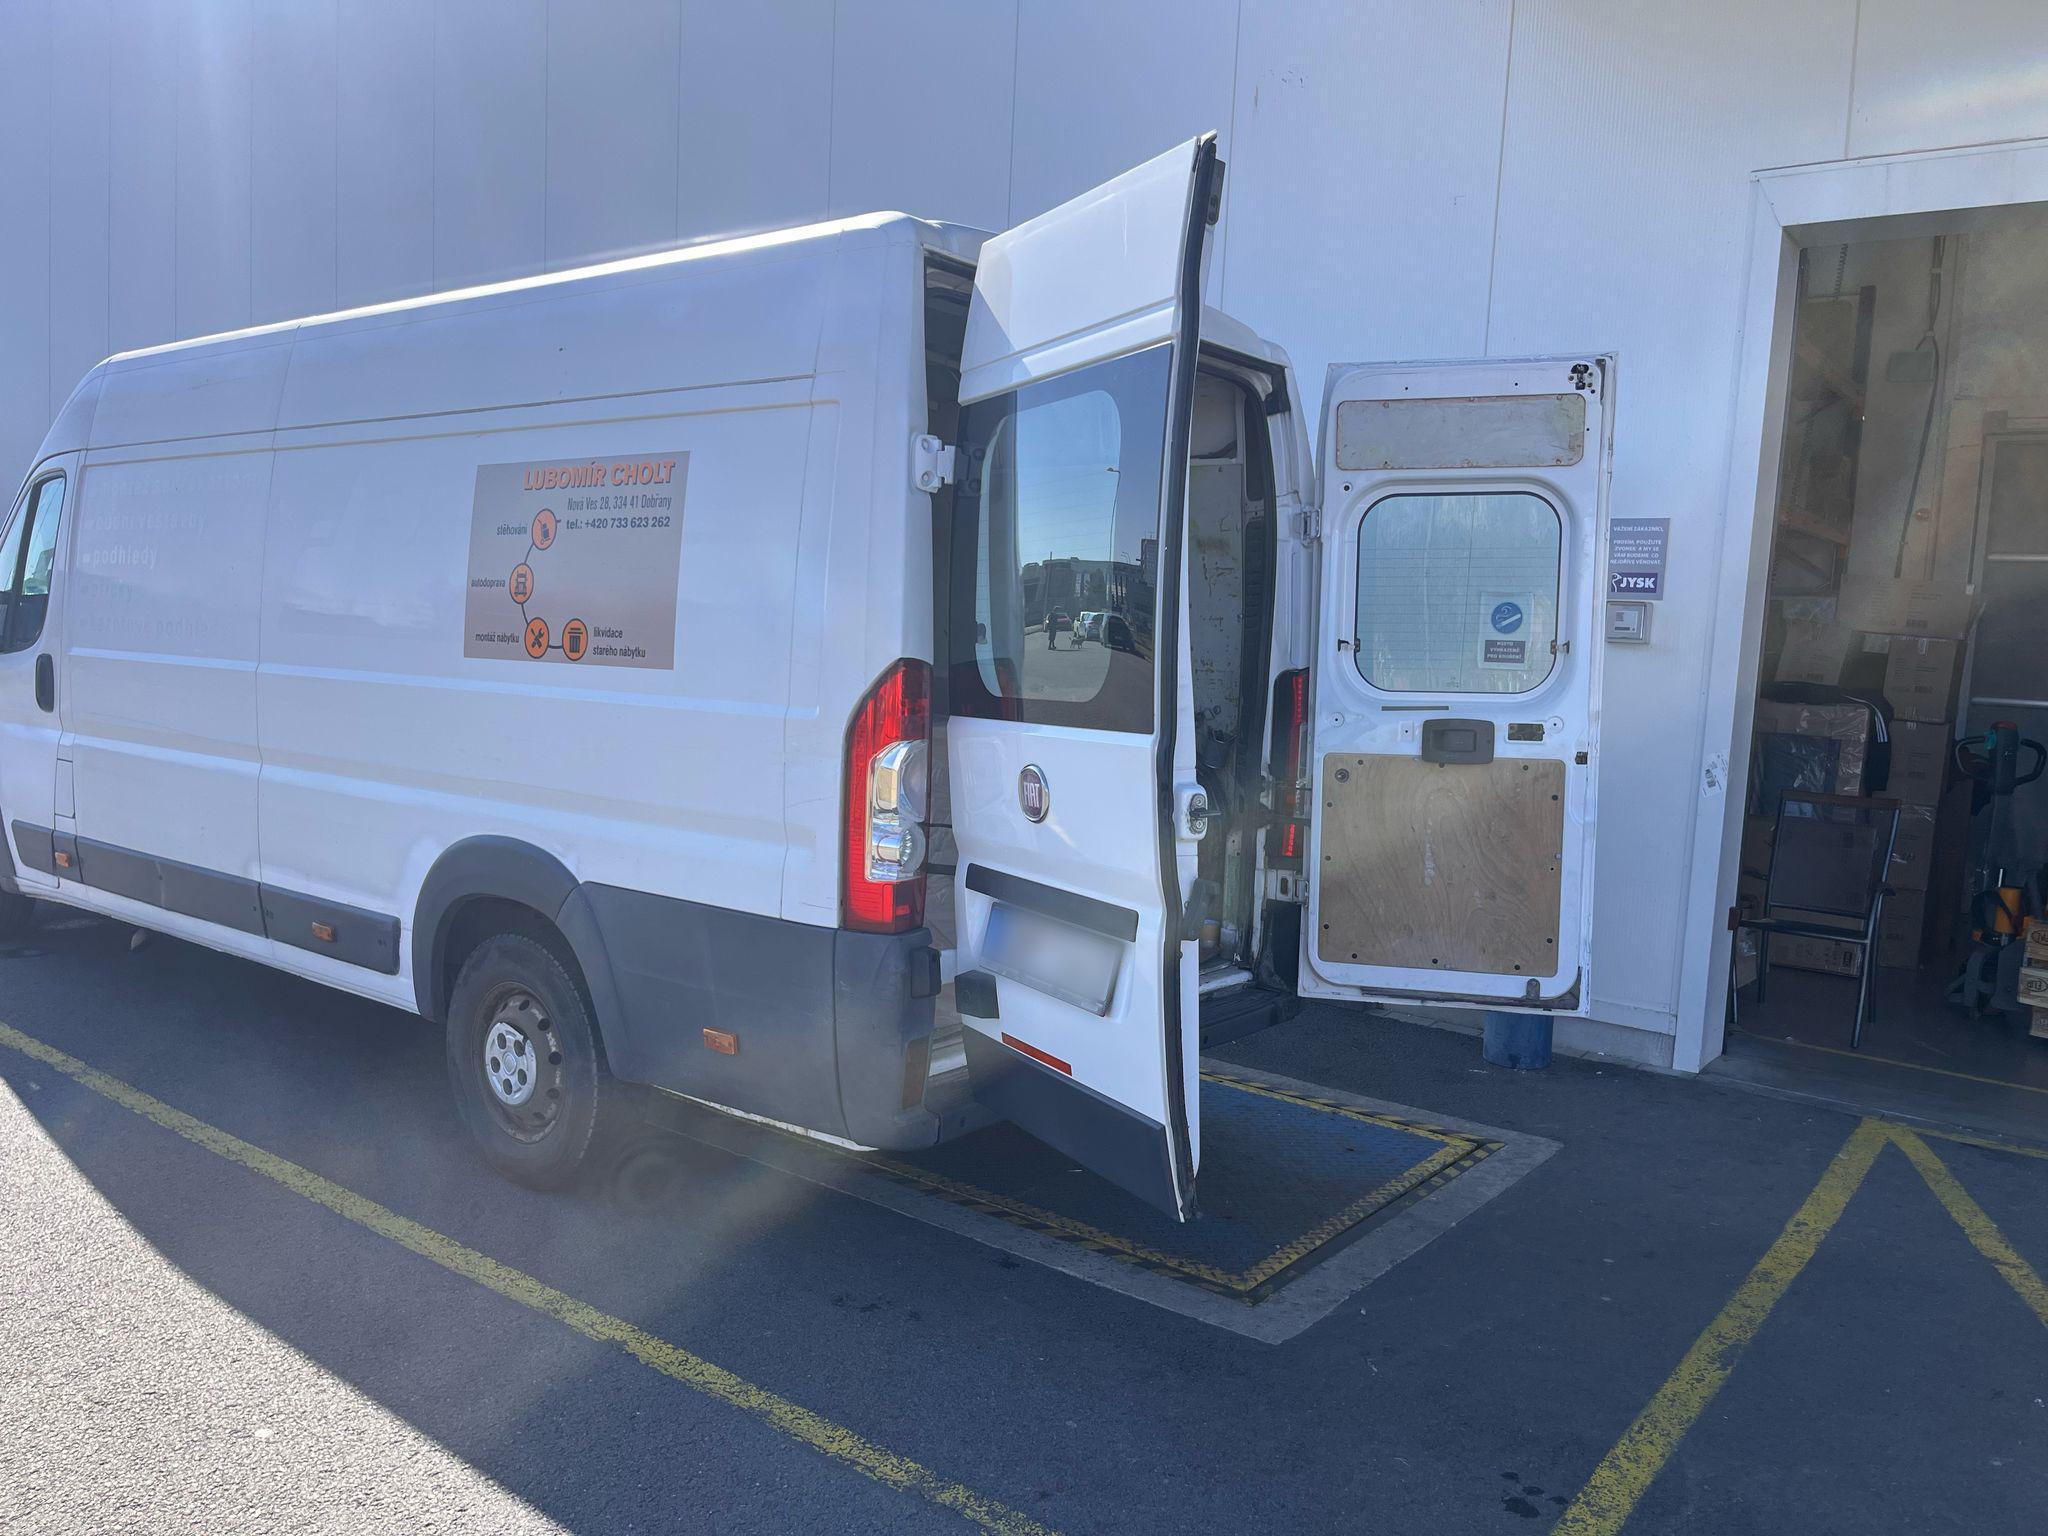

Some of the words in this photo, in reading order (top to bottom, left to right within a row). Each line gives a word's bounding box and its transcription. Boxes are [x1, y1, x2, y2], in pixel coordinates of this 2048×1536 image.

[523, 461, 607, 490] LUBOMÍR
[611, 460, 676, 486] CHOLT
[567, 496, 585, 511] Nová
[586, 497, 598, 510] Ves
[613, 496, 628, 509] 334
[630, 495, 639, 509] 41
[641, 493, 672, 511] Dobřany
[496, 523, 528, 536] stěhování
[566, 519, 583, 530] tel.:
[585, 518, 608, 529] +420
[611, 517, 628, 529] 733
[630, 516, 649, 528] 623
[651, 516, 671, 528] 262
[470, 577, 506, 591] autodoprava
[1620, 577, 1655, 588] JYSK
[475, 631, 496, 643] montáž
[496, 632, 520, 645] nábytku
[593, 626, 623, 639] likvidace
[592, 644, 618, 657] starého
[618, 645, 646, 659] nábytku
[1023, 781, 1040, 808] FIAT
